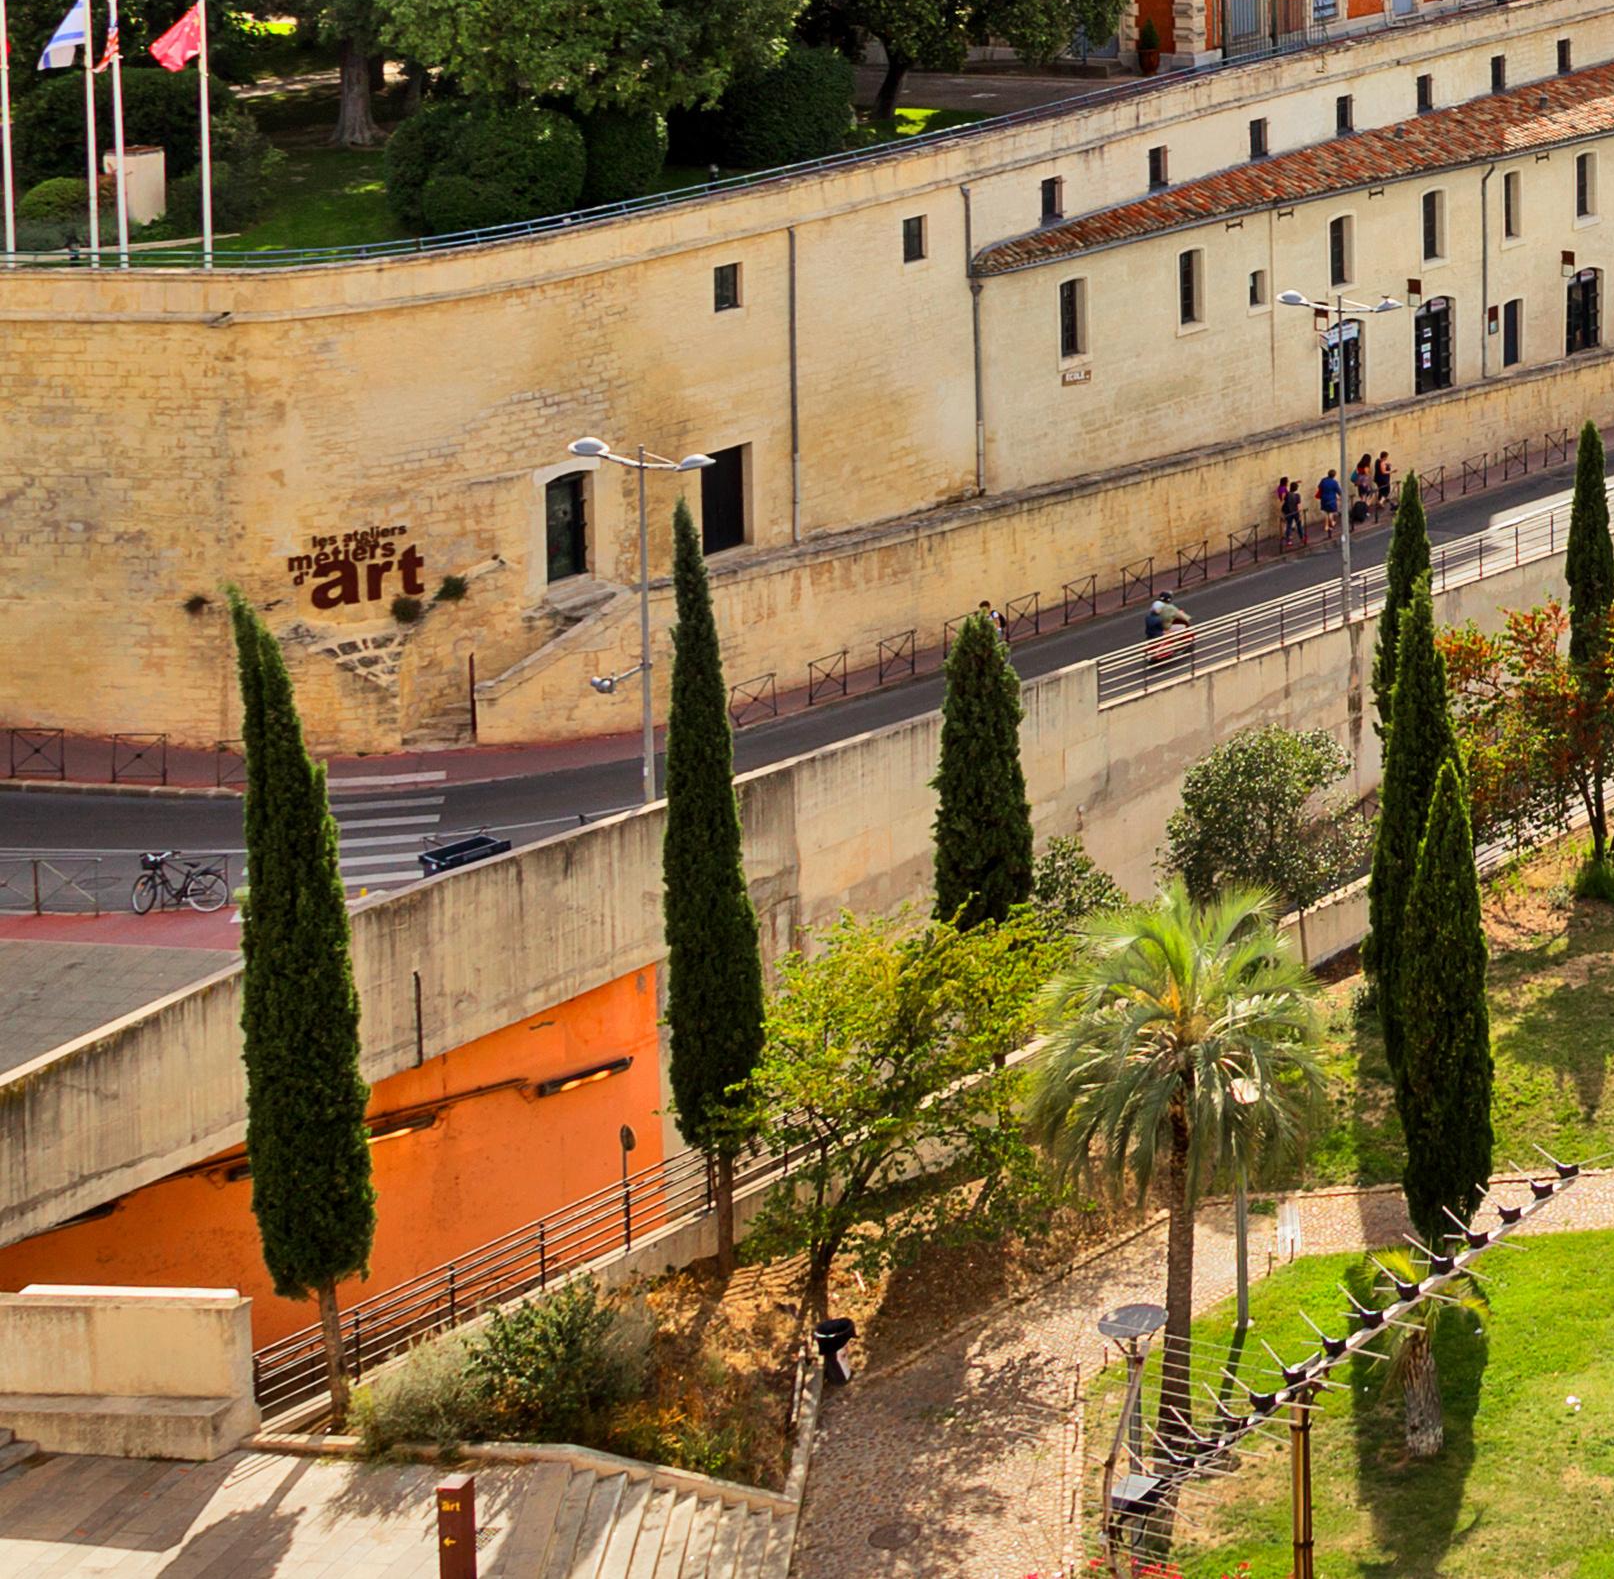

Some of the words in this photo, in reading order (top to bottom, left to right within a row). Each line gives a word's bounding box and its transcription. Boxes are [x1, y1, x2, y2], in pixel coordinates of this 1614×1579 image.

[312, 535, 337, 549] les
[342, 524, 407, 545] ateliers
[441, 1501, 460, 1512] art
